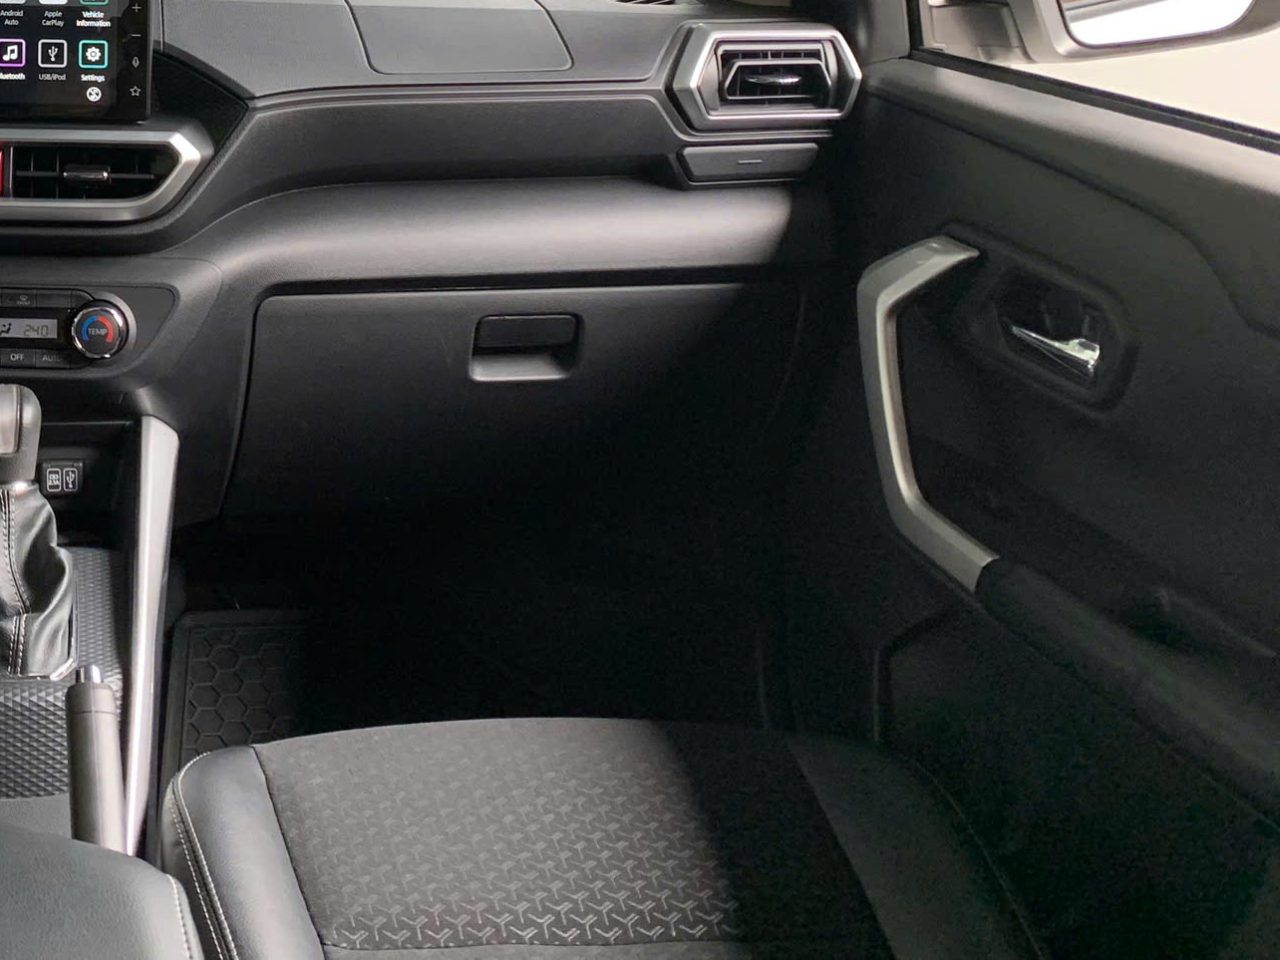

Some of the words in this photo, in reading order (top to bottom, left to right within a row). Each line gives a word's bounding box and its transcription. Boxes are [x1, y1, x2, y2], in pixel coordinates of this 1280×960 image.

[44, 11, 63, 19] Apple
[82, 11, 105, 19] Vehicle
[41, 19, 65, 27] CarPlay
[76, 19, 112, 28] Information
[38, 73, 66, 81] USB/iPod
[80, 74, 106, 83] Settings
[88, 327, 108, 335] TEMP
[10, 352, 25, 361] OFF
